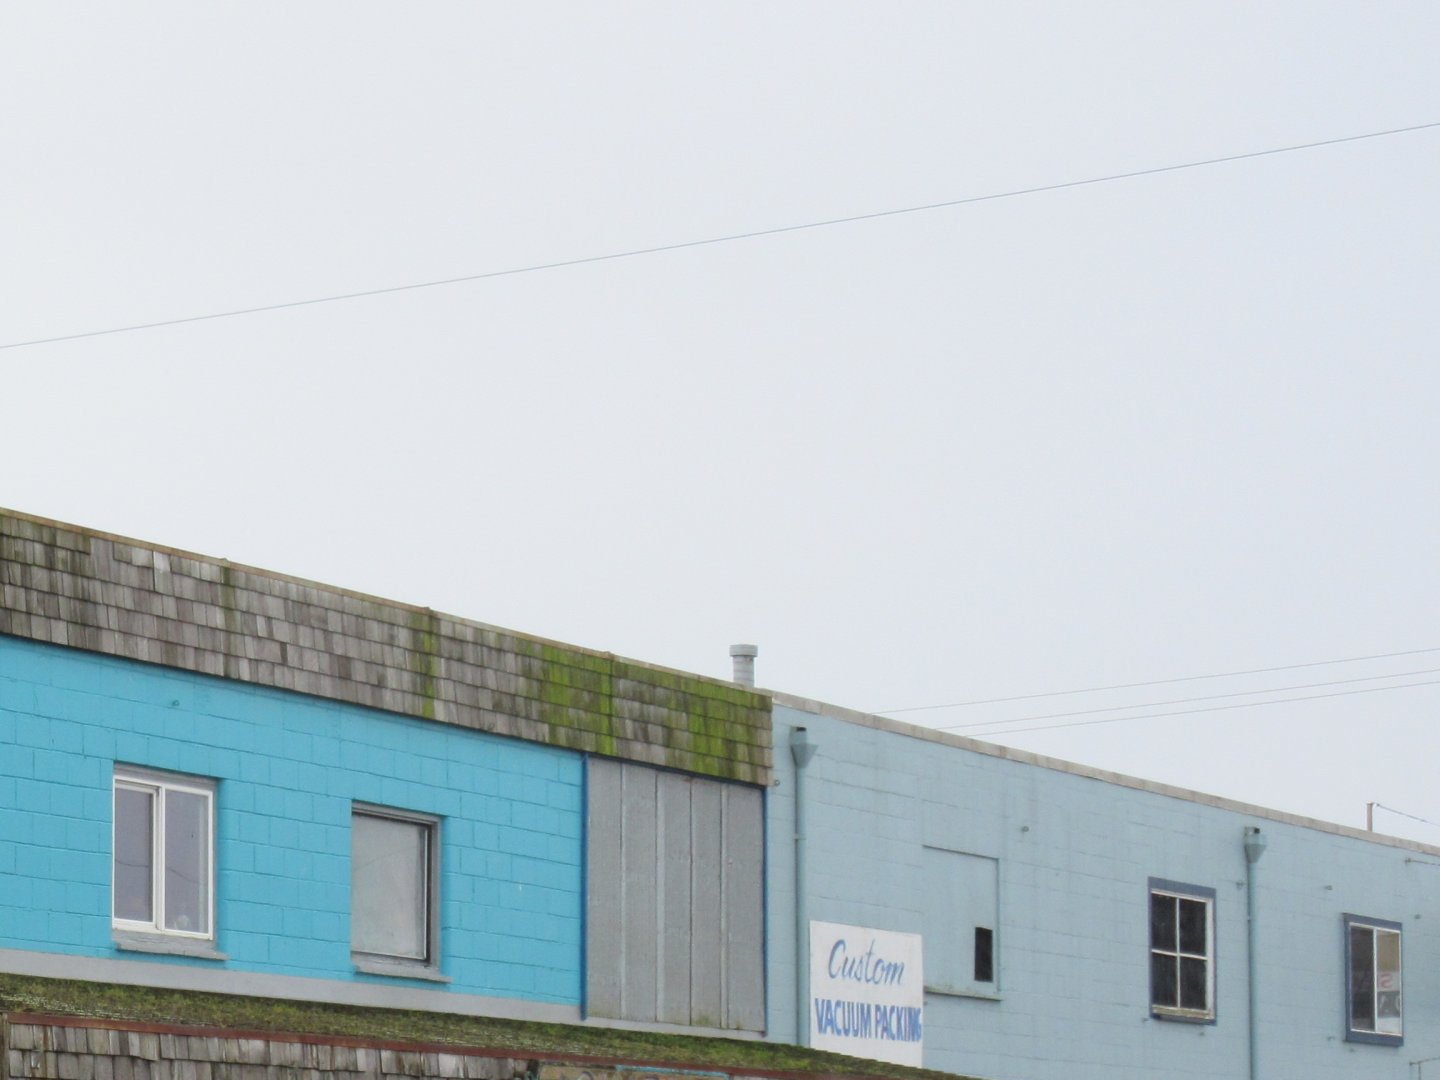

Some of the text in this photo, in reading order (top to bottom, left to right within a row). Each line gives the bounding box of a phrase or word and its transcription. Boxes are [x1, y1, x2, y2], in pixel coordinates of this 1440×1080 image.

[827, 938, 905, 985] Custom
[815, 998, 922, 1043] VACUUM PACKING
